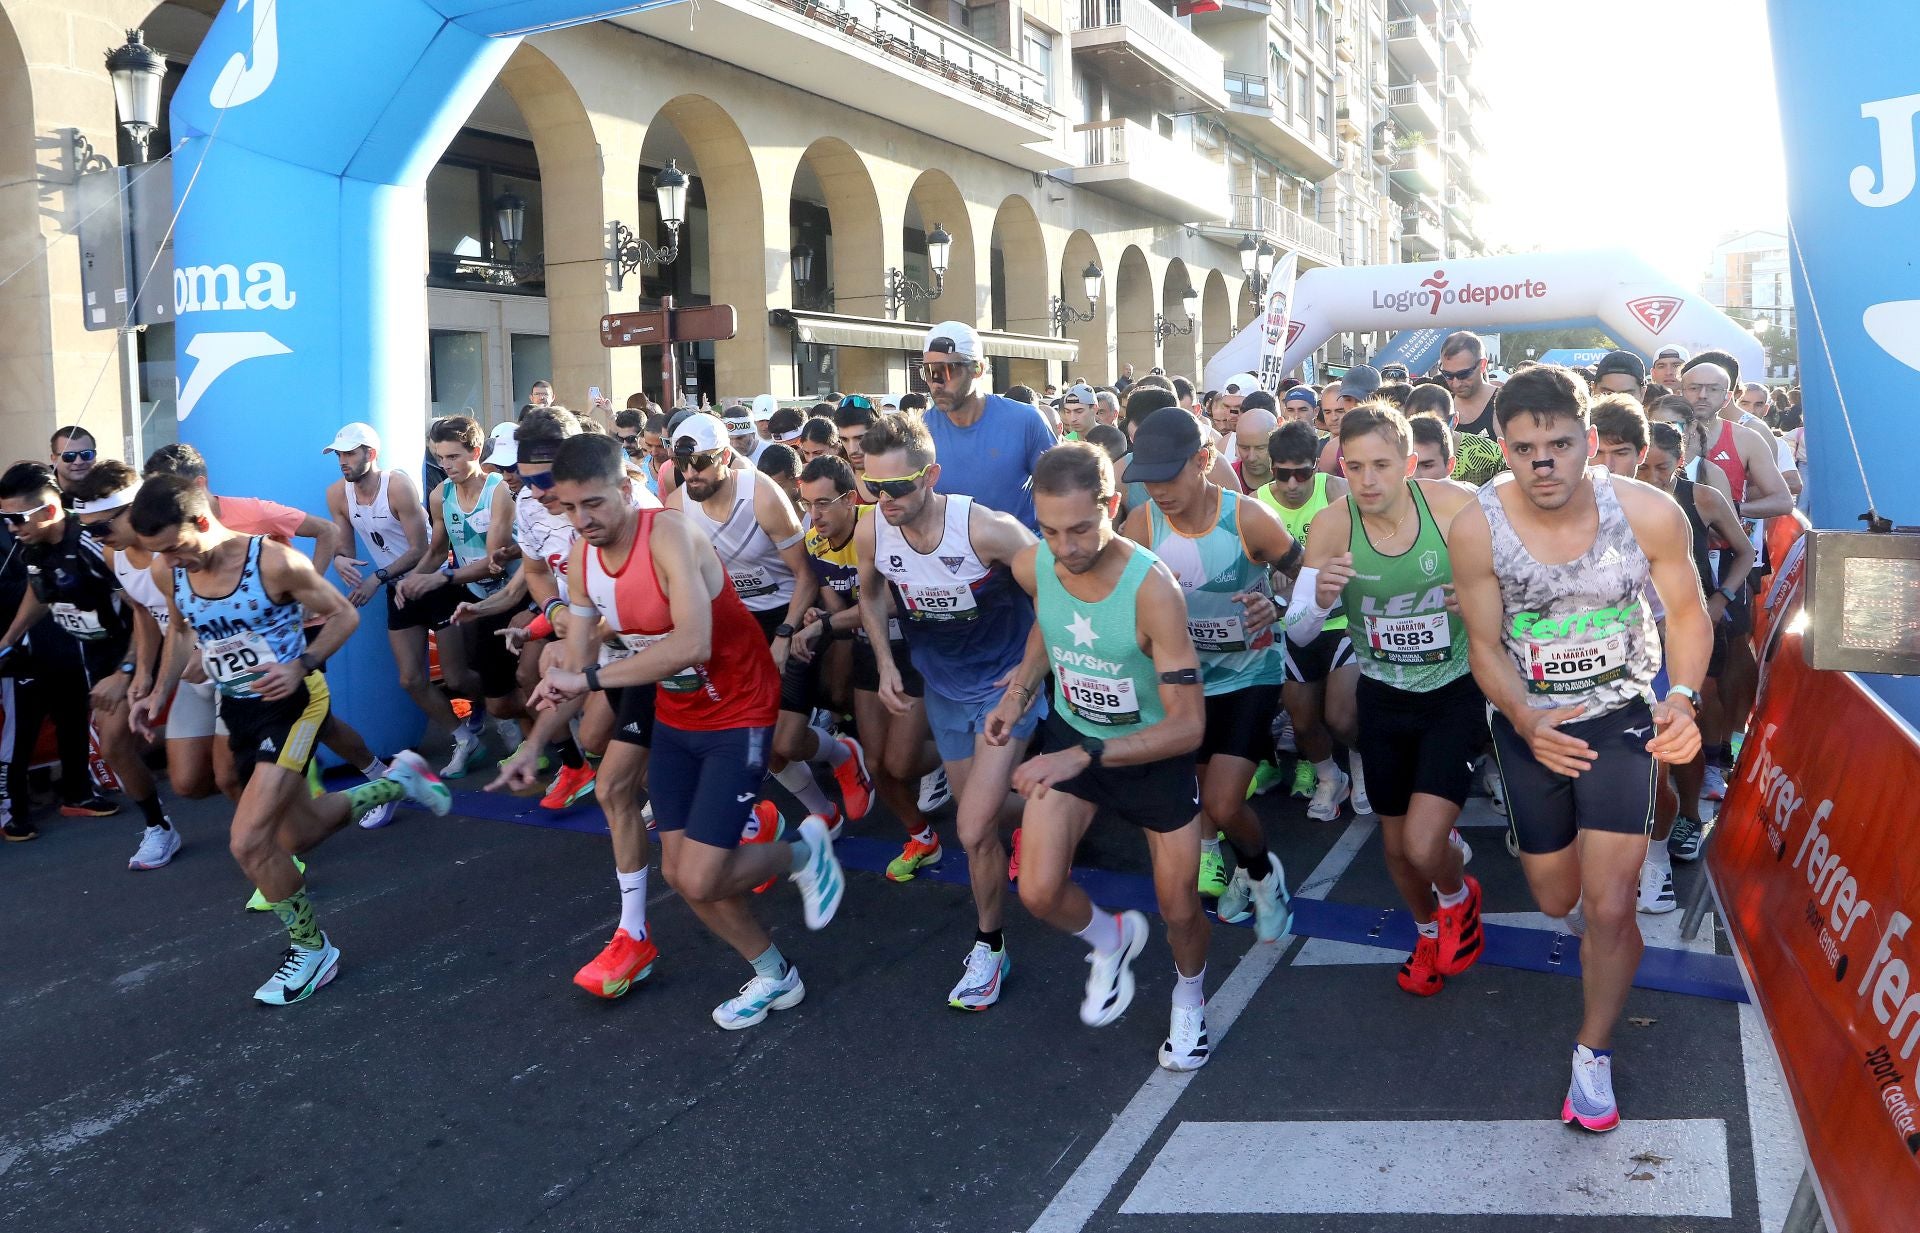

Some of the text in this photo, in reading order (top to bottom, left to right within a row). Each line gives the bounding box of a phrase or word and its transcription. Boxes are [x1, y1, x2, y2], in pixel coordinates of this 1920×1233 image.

[173, 261, 296, 316] oma
[1458, 278, 1547, 306] deporte
[915, 597, 958, 608] 1267
[1360, 584, 1446, 617] LEA
[1188, 627, 1229, 639] 1875
[1386, 621, 1426, 632] LA MARATÓN
[1510, 599, 1641, 640] Ferrer
[1381, 630, 1434, 646] 1683
[1051, 645, 1124, 676] SAYSKY
[1544, 654, 1607, 675] 2061
[1551, 647, 1599, 660] LA MARATÓN
[1070, 686, 1120, 708] 1398
[1746, 723, 1804, 832] Ferrer
[1792, 799, 1872, 942] Ferrer
[1819, 927, 1840, 969] center
[1865, 1044, 1917, 1141] sport center
